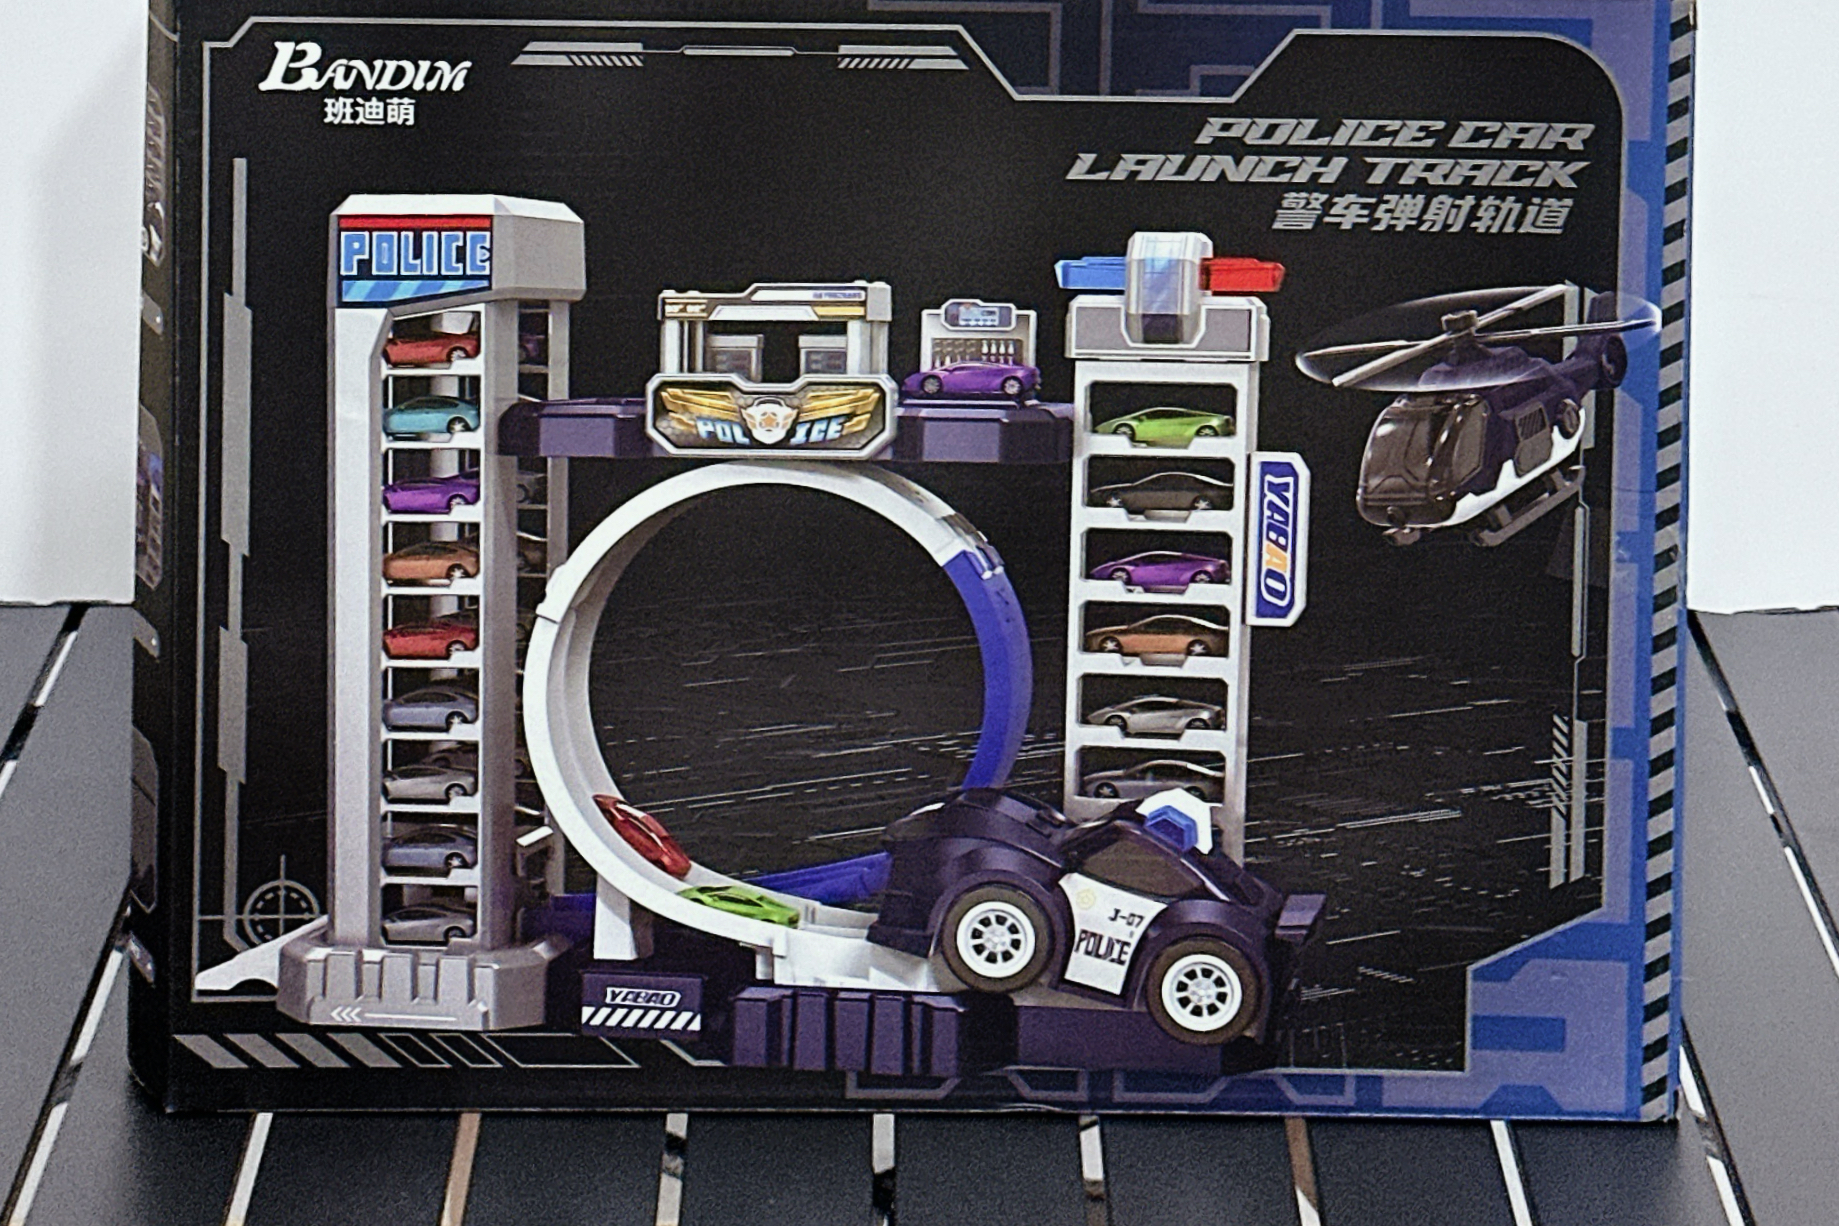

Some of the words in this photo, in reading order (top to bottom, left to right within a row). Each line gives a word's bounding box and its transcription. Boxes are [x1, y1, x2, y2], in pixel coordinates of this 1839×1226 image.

[258, 41, 472, 91] BANDIM
[323, 96, 416, 125] 班迪萌
[1194, 116, 1447, 148] POLICE
[1447, 120, 1596, 151] CAR
[1065, 153, 1349, 182] LAUNCH
[1364, 157, 1591, 188] TRACK
[1272, 191, 1574, 234] 警车弹射轨道
[340, 231, 491, 275] POLICE
[1260, 473, 1294, 608] YABAO
[1107, 908, 1145, 928] J-07
[606, 987, 682, 1008] YABAO
